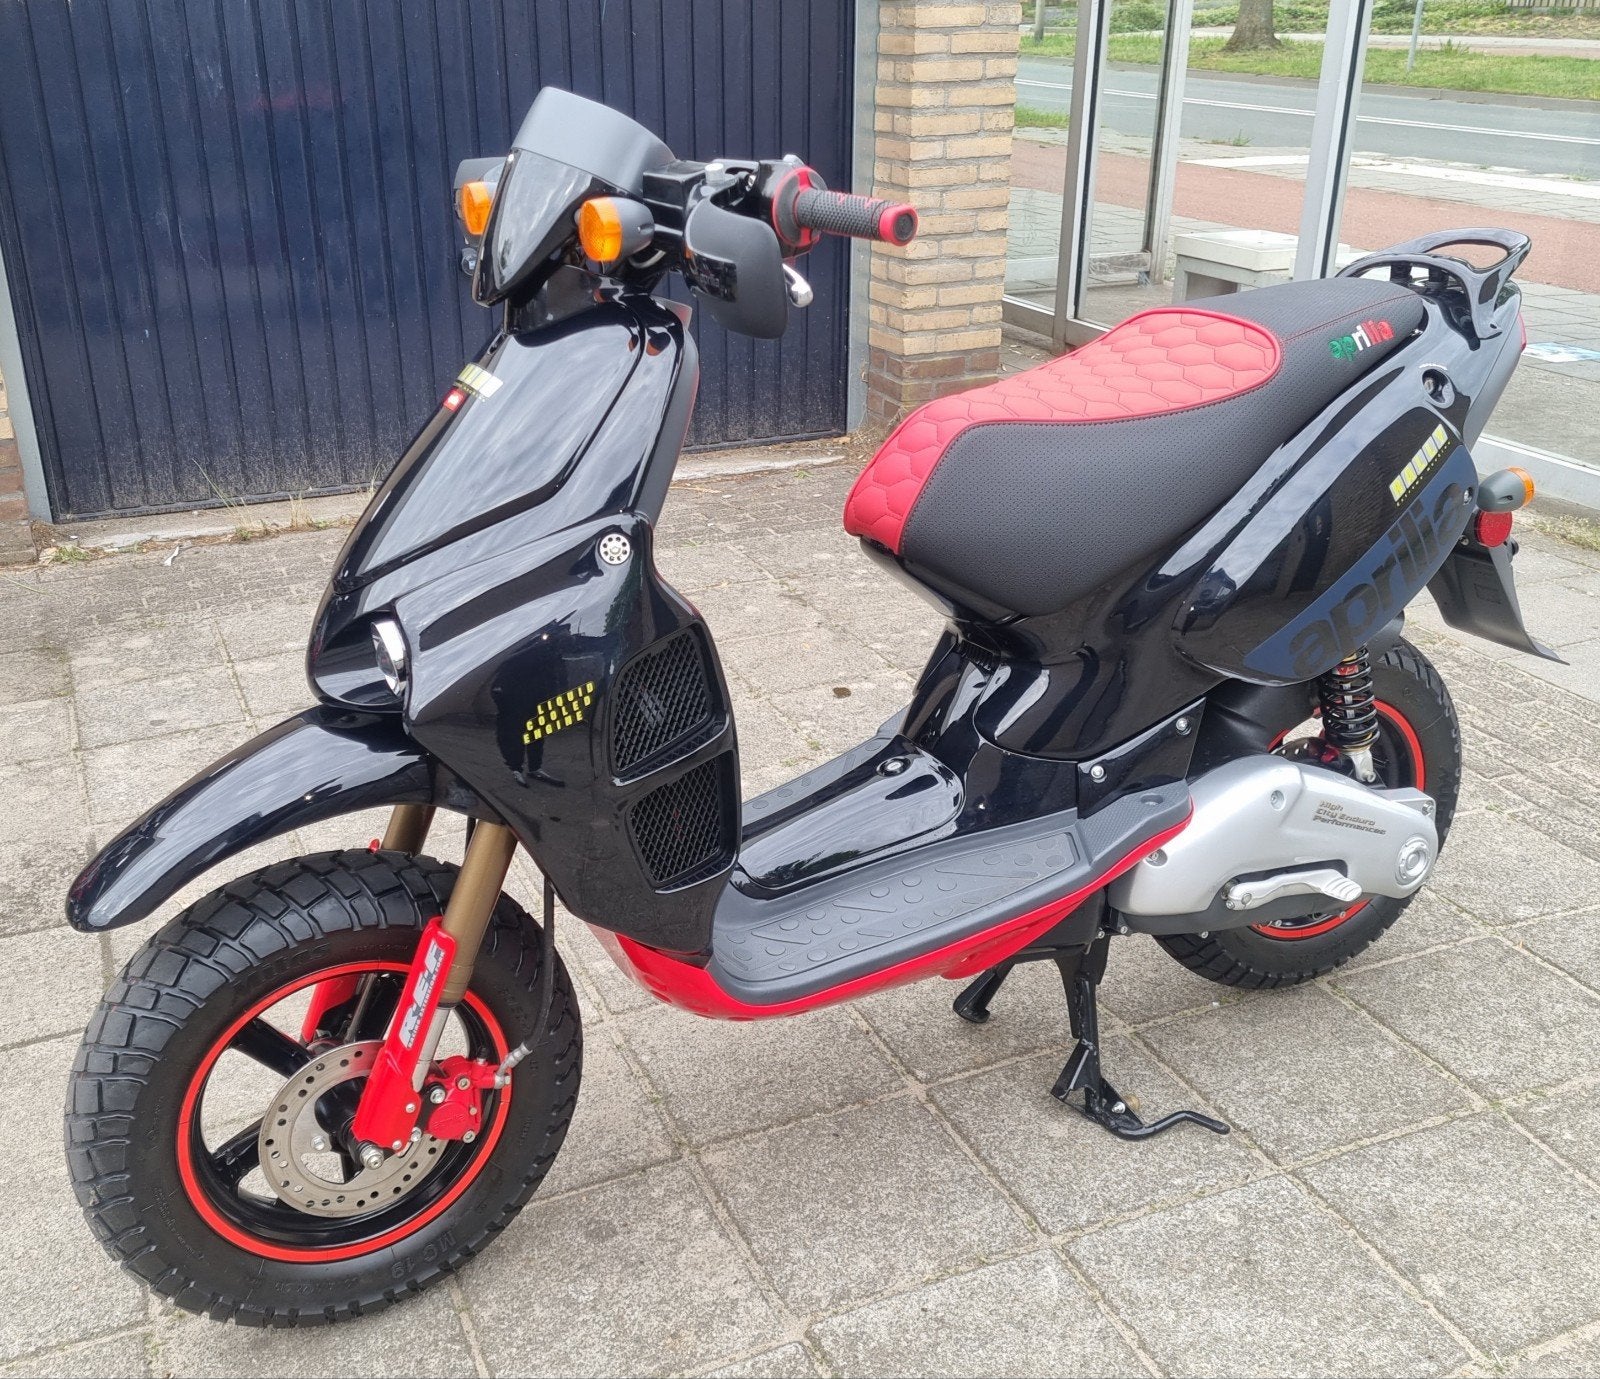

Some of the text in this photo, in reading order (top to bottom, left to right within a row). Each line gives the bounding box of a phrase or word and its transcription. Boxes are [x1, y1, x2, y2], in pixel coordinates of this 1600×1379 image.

[1328, 320, 1395, 361] aprilia
[1289, 483, 1464, 678] aprilia
[526, 696, 591, 731] COOLED
[537, 682, 594, 715] LIQUID
[523, 711, 583, 745] ENGINE
[1316, 808, 1376, 826] City Enduro
[1319, 801, 1344, 811] High
[1313, 815, 1386, 834] Performances
